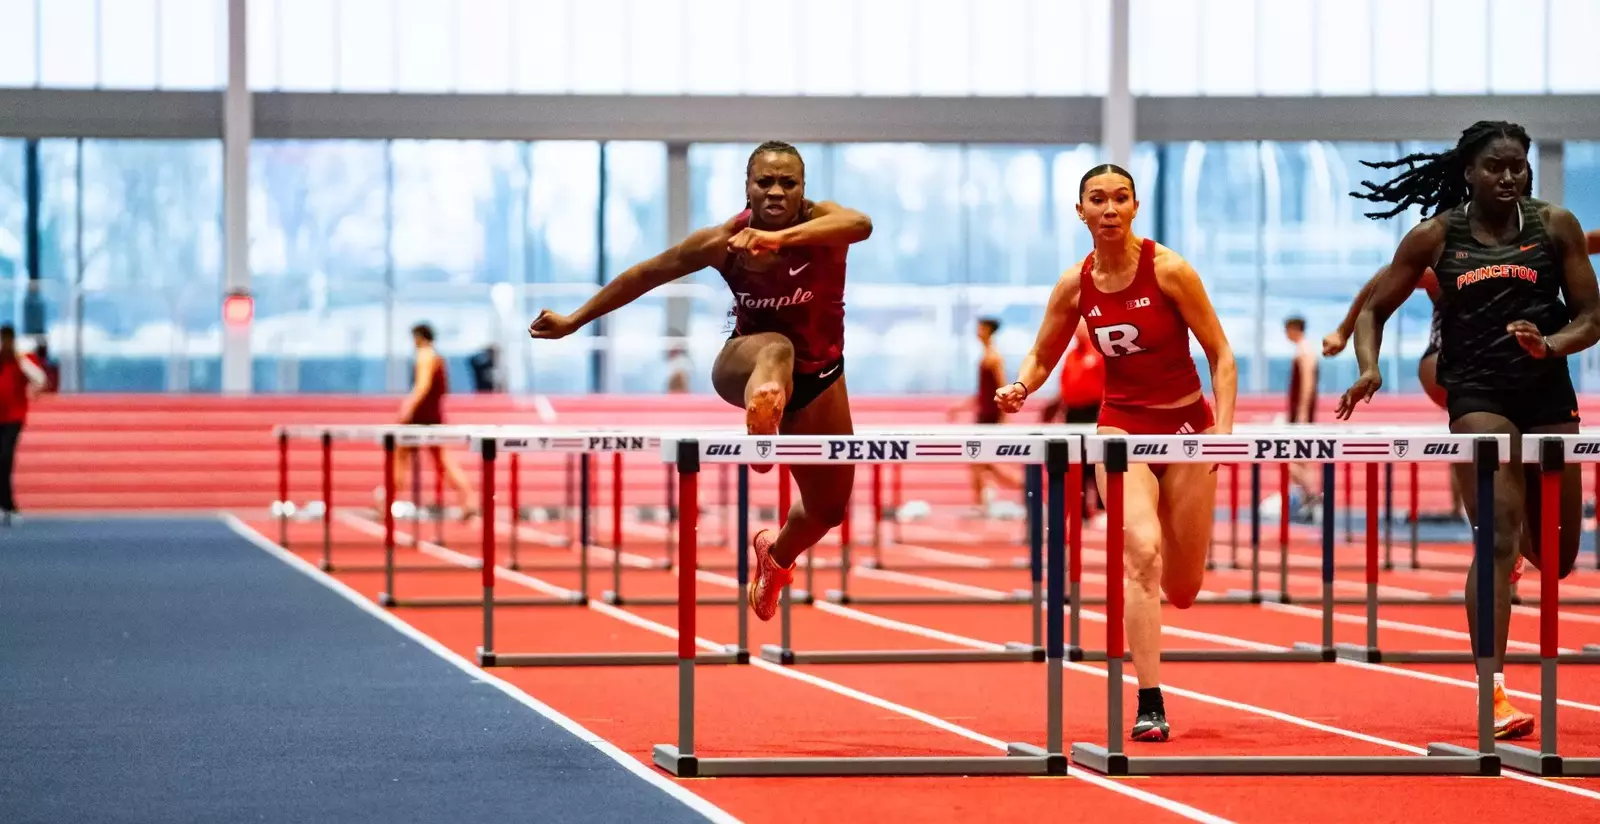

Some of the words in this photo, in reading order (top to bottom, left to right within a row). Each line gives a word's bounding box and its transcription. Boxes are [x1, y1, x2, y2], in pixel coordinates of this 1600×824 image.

[1457, 264, 1538, 290] PRINCETON
[736, 287, 814, 311] Temple
[1094, 323, 1147, 357] R
[589, 437, 644, 450] PENN
[706, 444, 742, 456] GILL
[828, 440, 910, 460] PENN
[995, 444, 1031, 456] GILL
[1132, 443, 1168, 455] GILL
[1255, 440, 1337, 459] PENN
[1423, 443, 1460, 455] GILL
